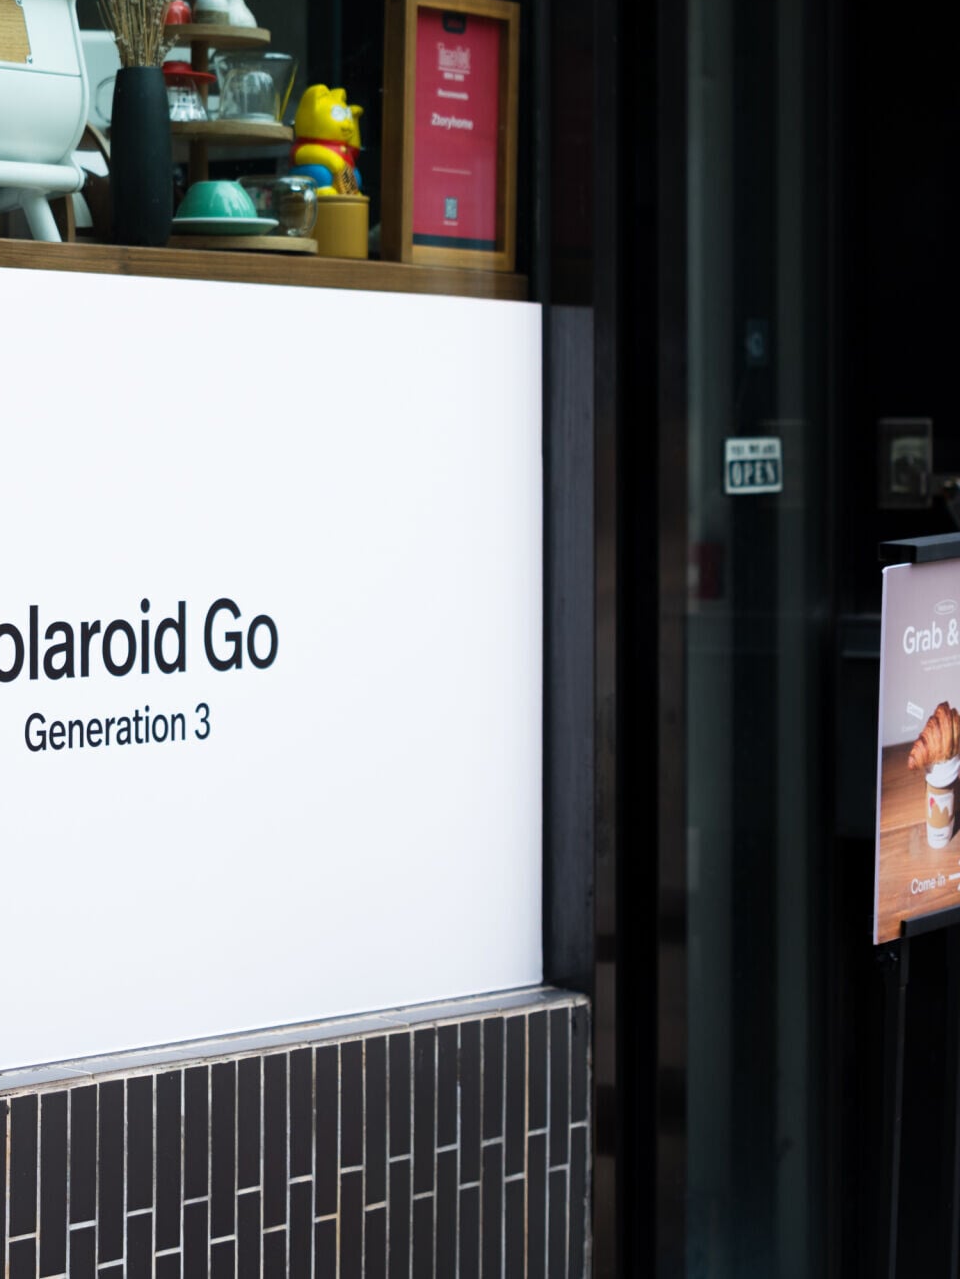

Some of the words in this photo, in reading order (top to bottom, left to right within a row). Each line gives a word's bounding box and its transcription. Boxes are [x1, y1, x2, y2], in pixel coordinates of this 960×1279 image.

[732, 461, 776, 486] OPEN
[203, 597, 279, 673] Go
[903, 620, 943, 655] Grab
[947, 618, 960, 646] &
[24, 704, 187, 753] Generation
[194, 702, 211, 740] 3
[911, 877, 936, 895] Come
